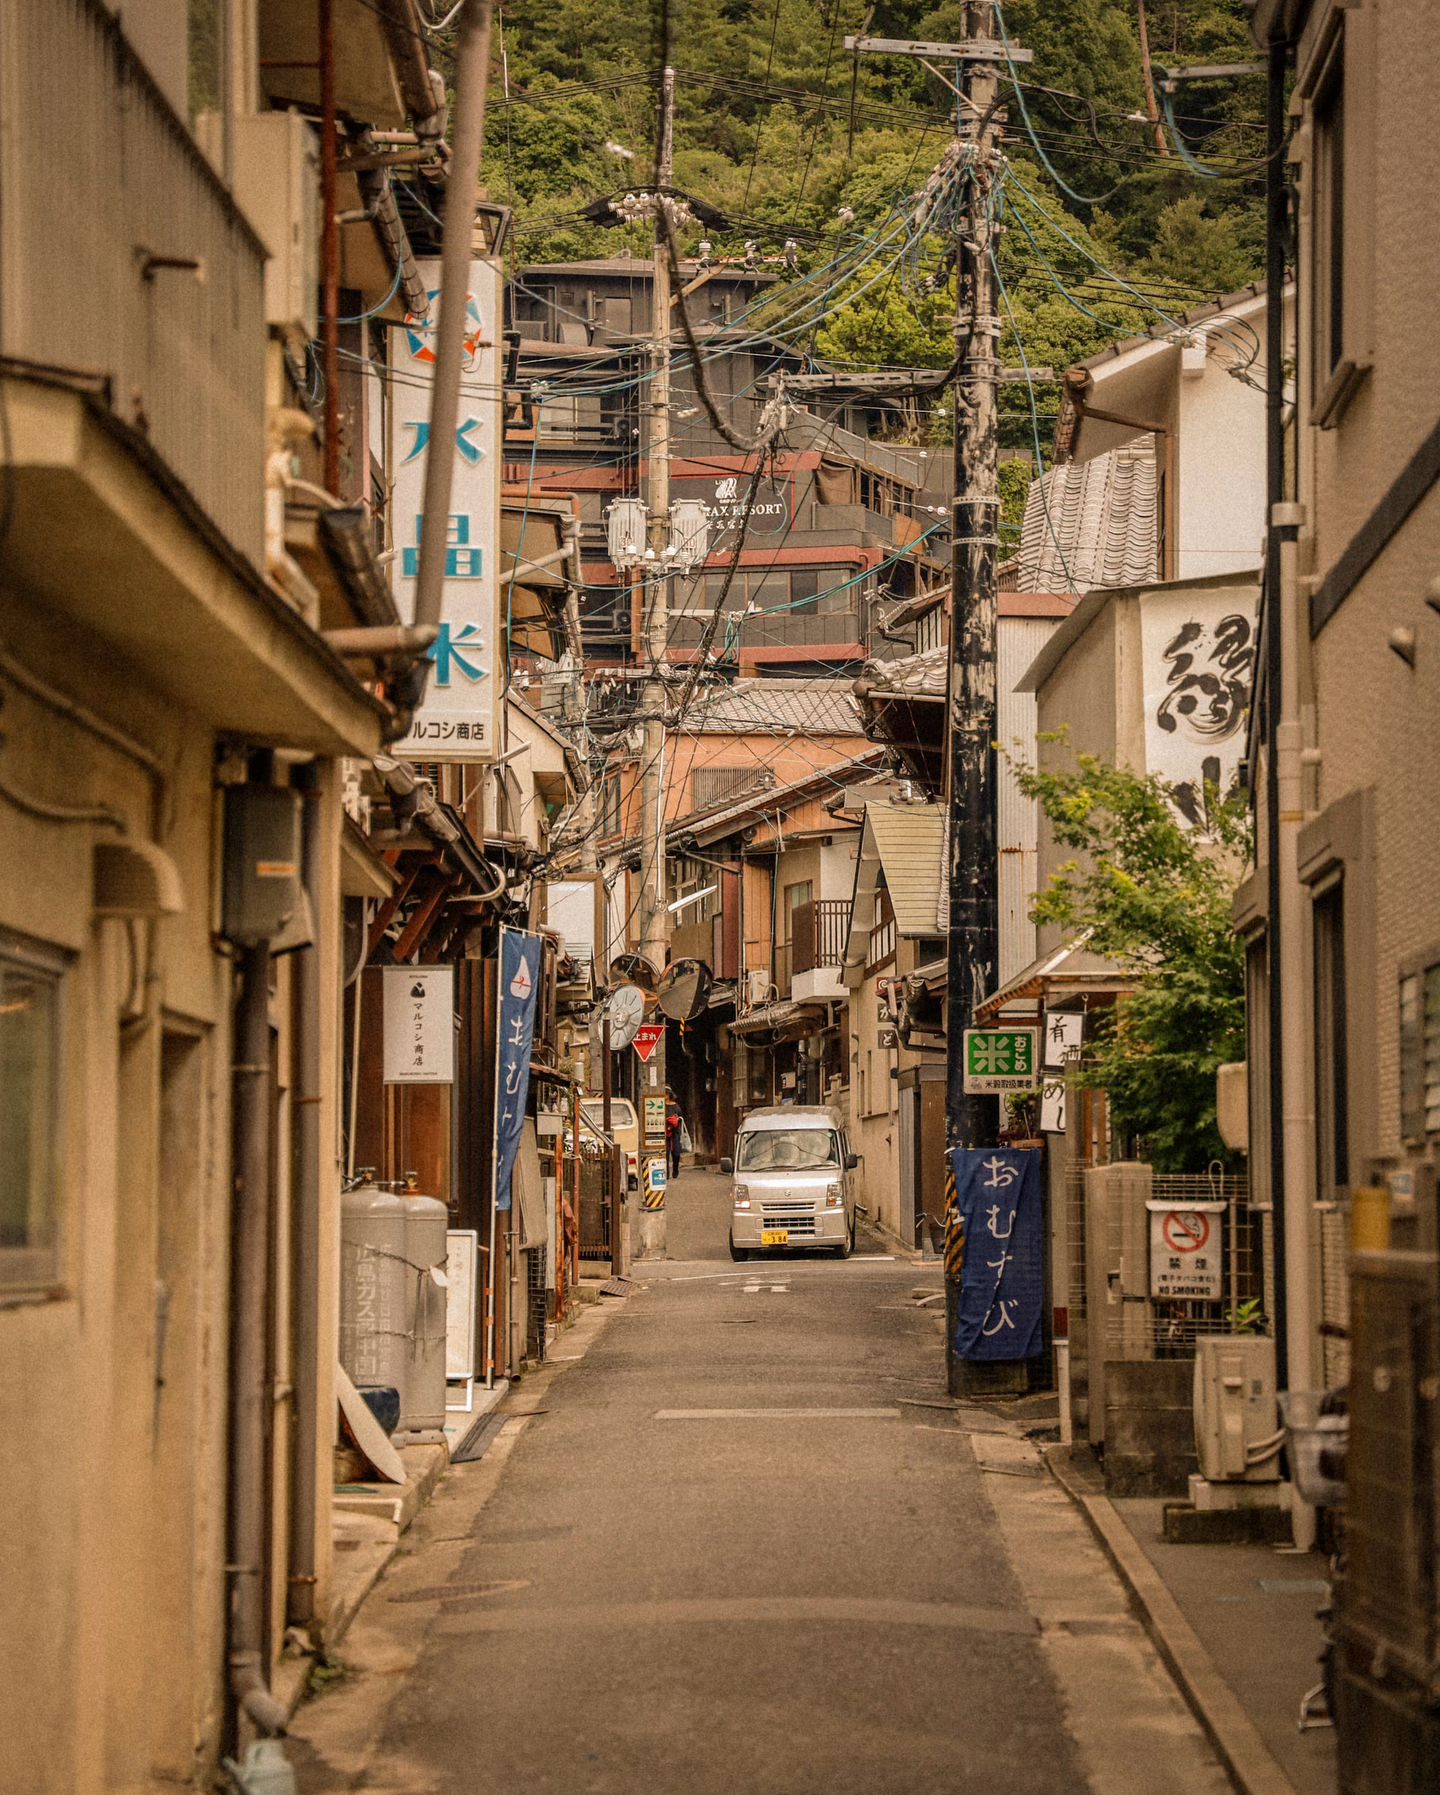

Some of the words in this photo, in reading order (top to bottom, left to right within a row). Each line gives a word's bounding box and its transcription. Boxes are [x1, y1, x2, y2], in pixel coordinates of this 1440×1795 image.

[406, 721, 485, 741] ルコシ商店
[412, 1002, 425, 1066] マルコシ商店
[973, 1035, 1010, 1073] 米
[1014, 1036, 1028, 1072] おこめ
[982, 1155, 1019, 1337] おむすび
[1158, 1286, 1170, 1295] NO
[1171, 1286, 1211, 1296] SMOKING
